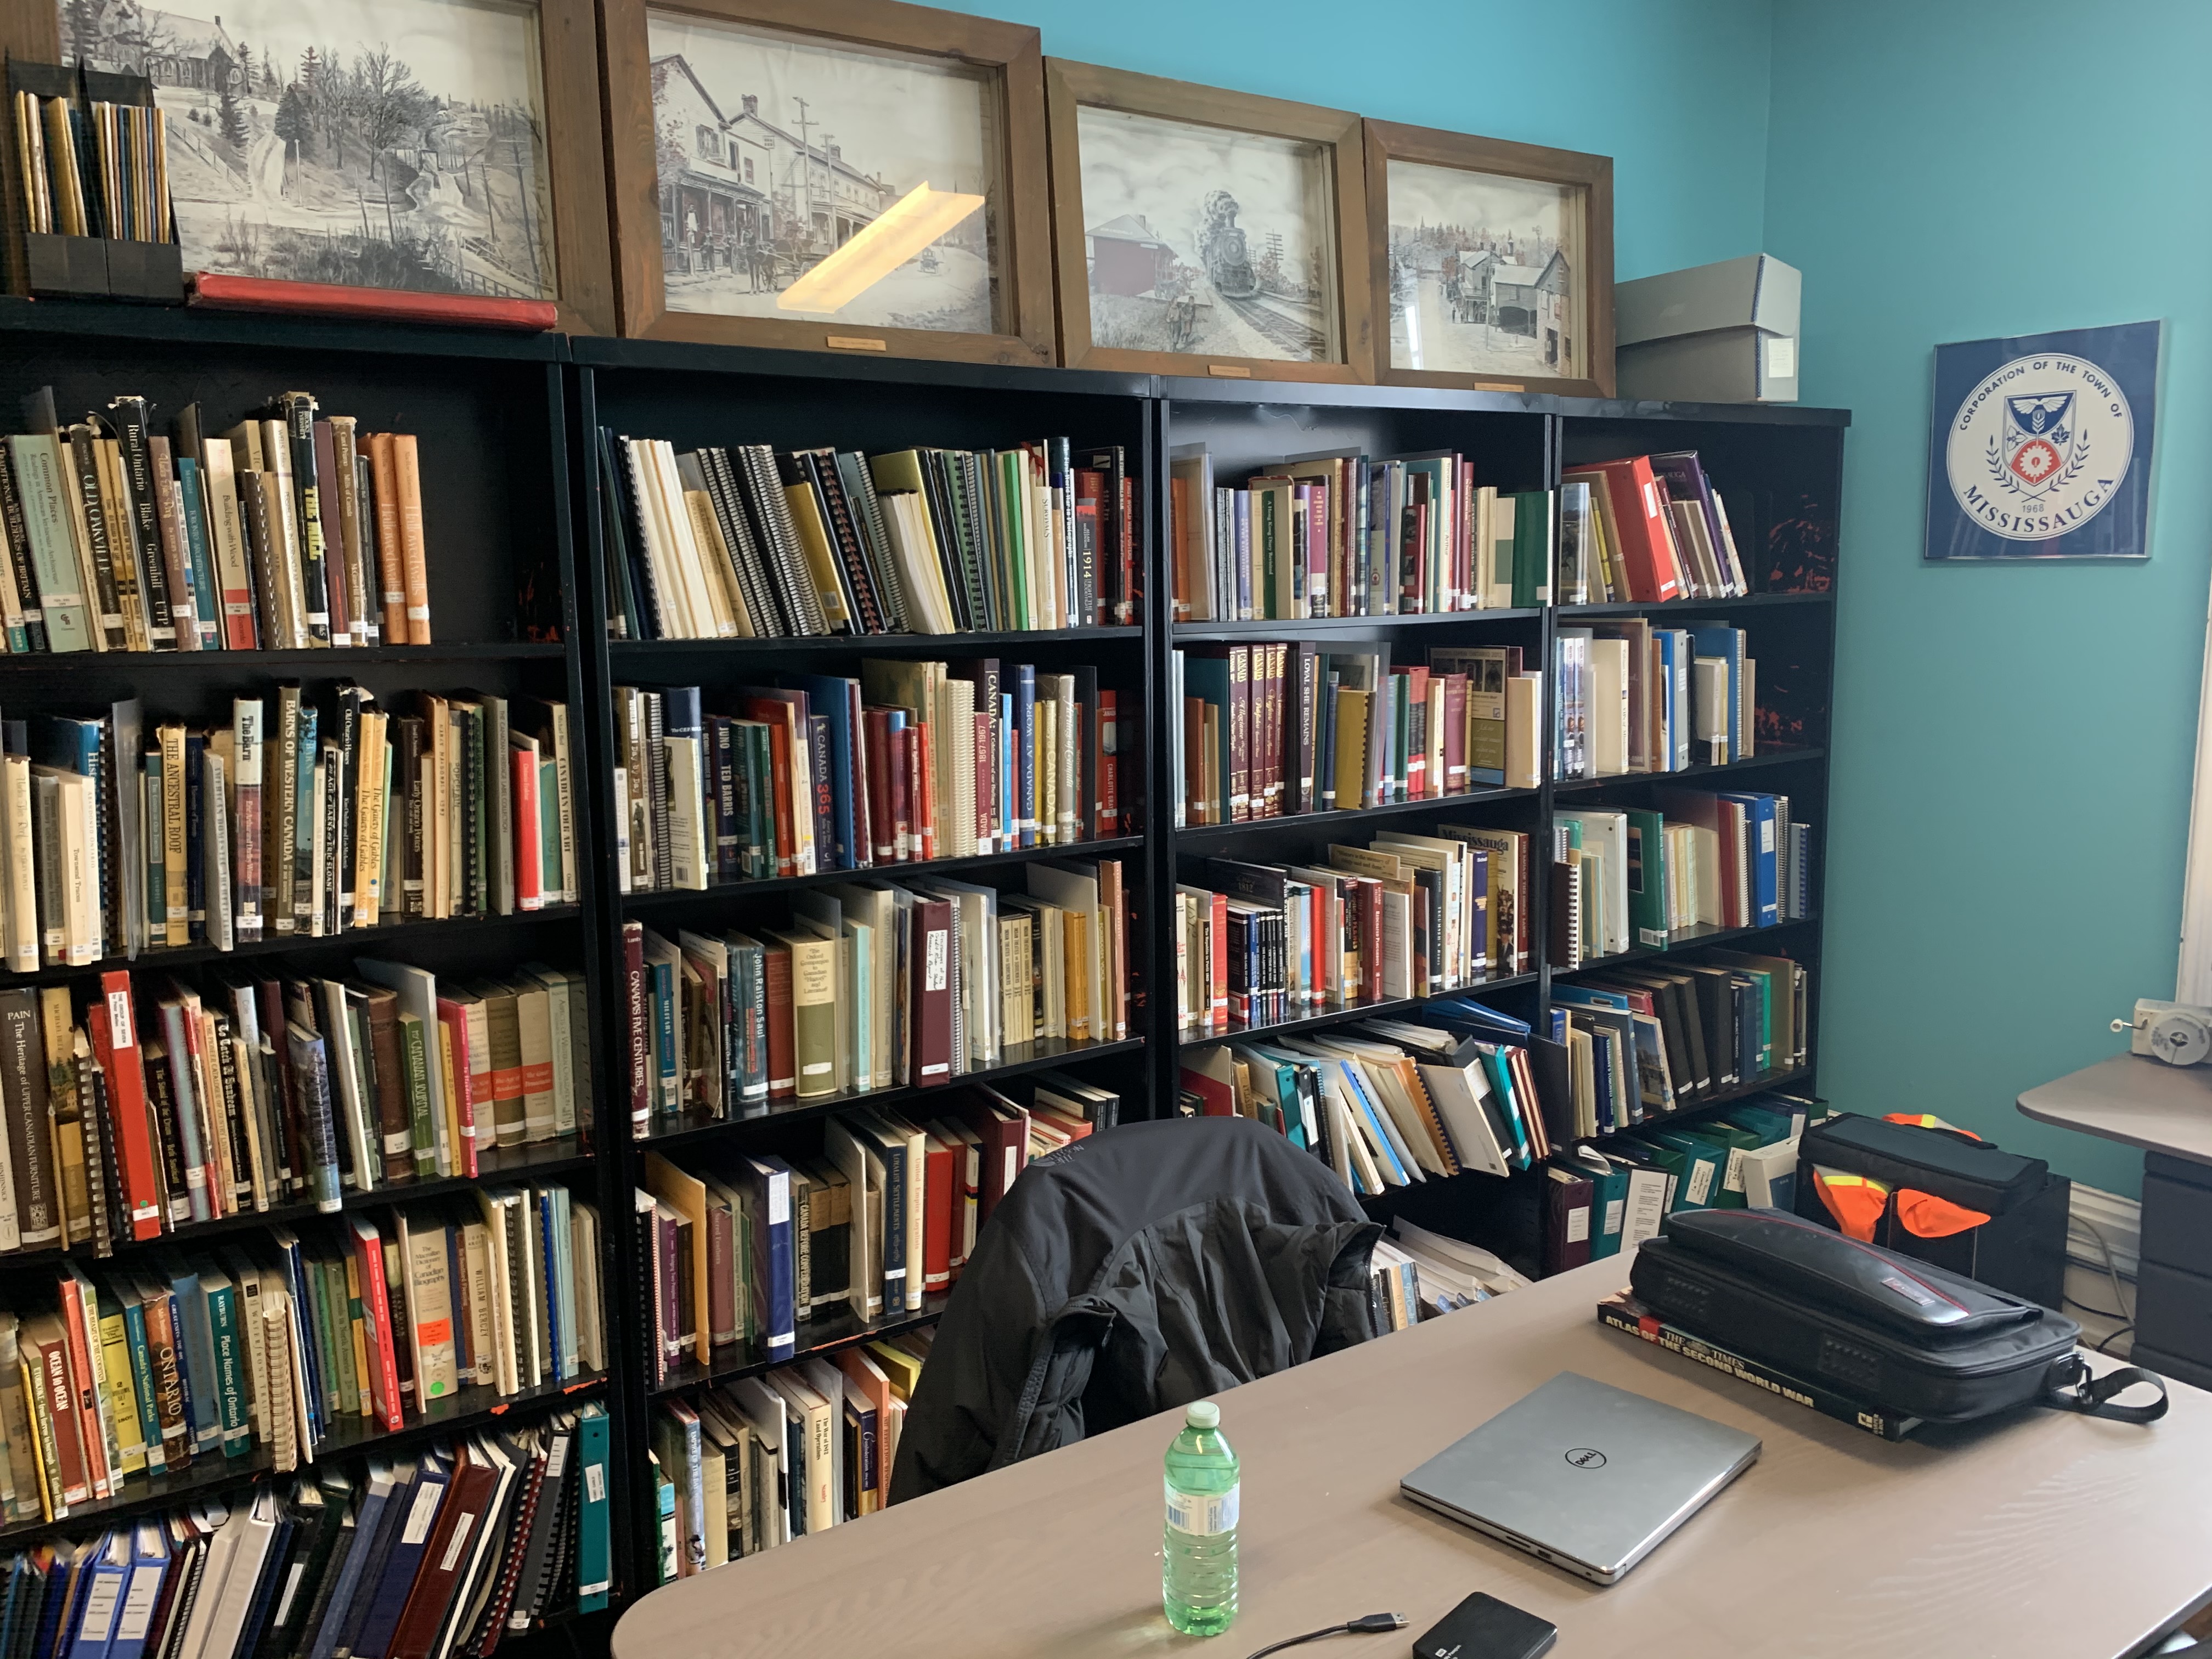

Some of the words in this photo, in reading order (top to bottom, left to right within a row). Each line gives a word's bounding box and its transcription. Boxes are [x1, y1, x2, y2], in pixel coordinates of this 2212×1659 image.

[1960, 365, 2025, 431] CORPORATION
[2033, 361, 2049, 370] OF
[2056, 362, 2077, 374] THE
[2082, 370, 2111, 398] TOWN
[2110, 403, 2123, 419] OF
[128, 425, 142, 450] Rural
[133, 454, 148, 490] Ontario
[40, 452, 54, 493] Common
[47, 495, 59, 523] Places
[222, 495, 234, 526] Building
[305, 486, 319, 519] THE
[1962, 477, 2115, 532] MISSISSAUGA
[2022, 504, 2045, 513] 1968
[139, 503, 154, 531] Blake
[1042, 498, 1051, 538] SURVIVALS
[89, 509, 111, 578] OAKVILLE
[227, 527, 236, 544] with
[307, 522, 324, 561] MILL
[145, 543, 163, 588] Greenhill
[229, 544, 240, 568] Wood
[1082, 551, 1092, 578] 1914
[155, 601, 170, 625] UTP
[236, 615, 247, 644] Toronto
[988, 674, 997, 729] CANADA:
[242, 716, 255, 735] The
[285, 700, 296, 738] BARNS
[166, 738, 179, 761] THE
[242, 735, 255, 761] Barn
[285, 741, 296, 757] OF
[719, 727, 730, 749] JUNO
[978, 725, 987, 763] 1867-1967
[1026, 742, 1033, 758] AT
[630, 746, 639, 761] Day
[817, 735, 827, 782] CANADA
[558, 757, 569, 808] CANADIAN
[631, 764, 640, 775] by
[721, 765, 732, 782] TED
[1046, 751, 1056, 816] CANADA
[167, 763, 181, 825] ANCESTRAL
[284, 759, 296, 813] WESTERN
[362, 790, 370, 805] The
[373, 788, 382, 802] The
[411, 780, 422, 798] Early
[632, 778, 640, 794] Day
[816, 783, 831, 815] 365
[413, 799, 422, 827] Ontario
[722, 785, 733, 816] BARRIS
[358, 807, 370, 833] Gaiety
[370, 804, 381, 831] Gaiety
[168, 826, 182, 854] ROOF
[283, 816, 296, 861] CANADA
[413, 829, 422, 853] Potters
[1441, 828, 1509, 855] Mississauga
[359, 844, 369, 872] Gables
[370, 842, 380, 870] Gables
[753, 953, 764, 976] John
[630, 970, 642, 1015] CANADA'S
[754, 978, 764, 1015] Ralston
[7, 1009, 31, 1020] PAIN
[631, 1015, 642, 1036] FIVE
[757, 1016, 765, 1039] Saul
[14, 1021, 25, 1039] The
[15, 1040, 28, 1075] Heritage
[219, 1039, 233, 1064] Catch
[633, 1036, 644, 1087] CENTURIES
[20, 1076, 30, 1085] of
[22, 1087, 33, 1111] UPPER
[223, 1076, 237, 1116] Sunbeam
[24, 1112, 36, 1158] CANADIAN
[29, 1158, 41, 1201] FURNITURE
[800, 1204, 809, 1230] CANADA
[800, 1230, 809, 1255] BEFORE
[913, 1218, 921, 1250] Loyalists
[414, 1267, 444, 1279] Canadian
[475, 1269, 486, 1302] WILLIAM
[800, 1255, 810, 1304] CONFEDERATION
[217, 1295, 228, 1327] RAYBURN
[137, 1344, 148, 1375] Canada's
[220, 1335, 231, 1357] Place
[1664, 1330, 1686, 1345] THE
[1712, 1350, 1745, 1370] TIMES
[48, 1351, 63, 1376] OCEAN
[223, 1358, 234, 1386] Names
[1606, 1315, 1640, 1336] ATLAS
[1641, 1330, 1658, 1343] OF
[1659, 1336, 1681, 1354] THE
[1683, 1344, 1734, 1374] SECOND
[1735, 1365, 1781, 1395] WORLD
[1782, 1387, 1815, 1408] WAR
[52, 1376, 64, 1385] to
[142, 1374, 153, 1403] National
[159, 1346, 182, 1415] ONTARIO
[224, 1386, 236, 1396] of
[54, 1385, 69, 1412] OCEAN
[145, 1403, 155, 1422] Parks
[228, 1396, 240, 1427] Ontario
[690, 1431, 699, 1455] EMPIRE
[691, 1455, 699, 1464] OF
[1575, 1451, 1598, 1466] DELL
